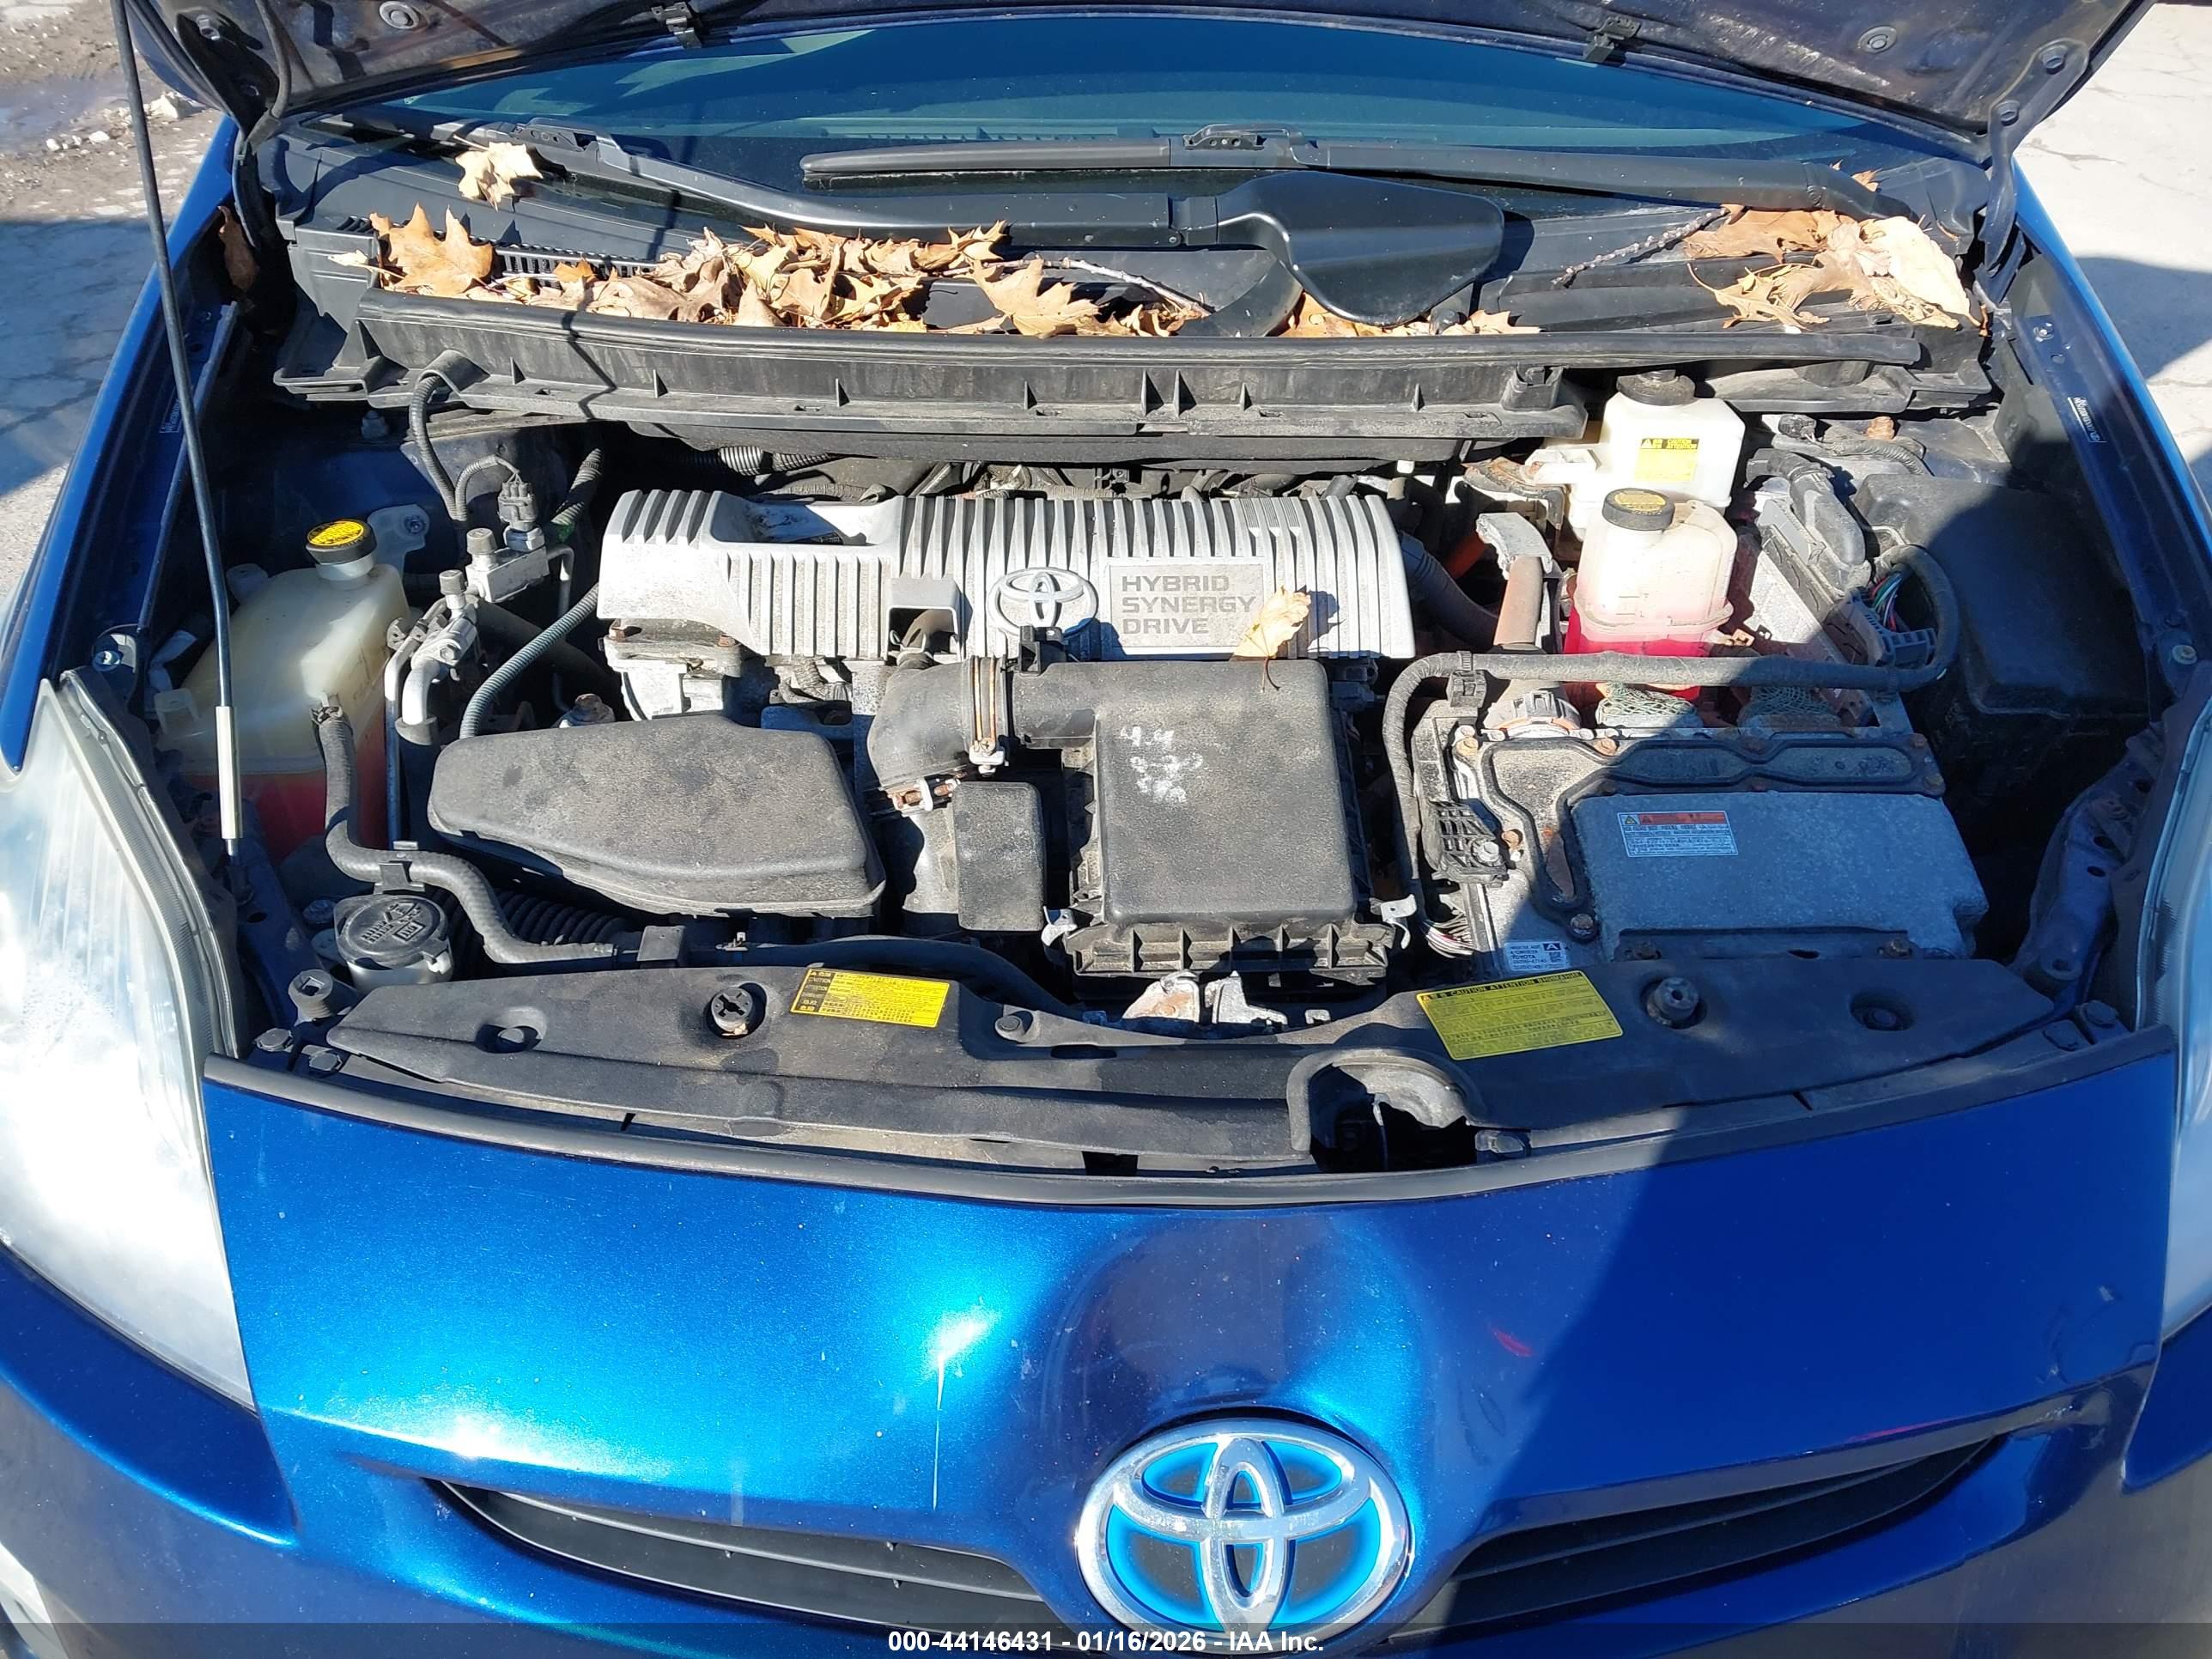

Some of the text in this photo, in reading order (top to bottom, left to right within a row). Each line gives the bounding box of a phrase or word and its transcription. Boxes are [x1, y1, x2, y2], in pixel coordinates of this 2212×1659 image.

[1122, 575, 1230, 592] HYBRID
[1122, 596, 1256, 613] SYNERGY
[1122, 618, 1209, 635] DRIVE
[1451, 986, 1486, 996] CAUTION
[1491, 979, 1535, 991] ATTENTION
